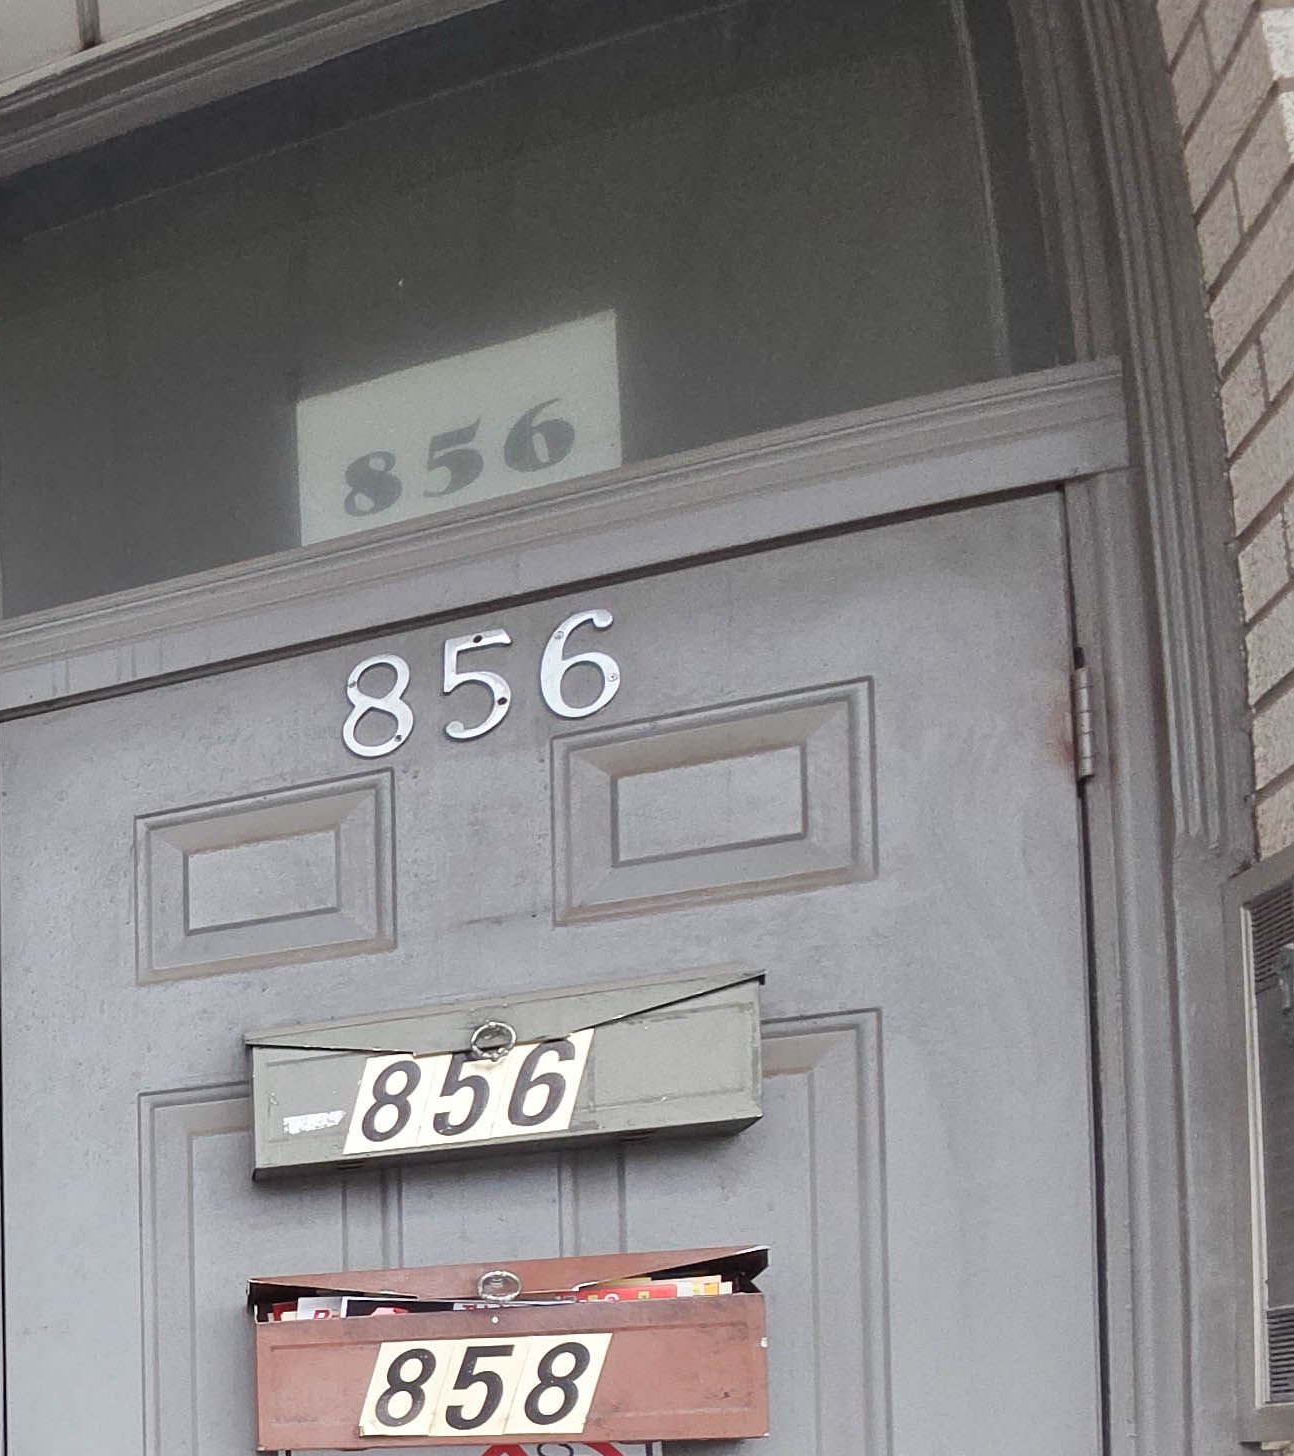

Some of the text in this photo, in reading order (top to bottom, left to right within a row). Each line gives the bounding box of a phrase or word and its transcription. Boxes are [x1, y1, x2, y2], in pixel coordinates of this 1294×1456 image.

[343, 398, 575, 518] 856
[342, 608, 621, 757] 856
[361, 1039, 576, 1143] 856
[373, 1341, 591, 1430] 858
